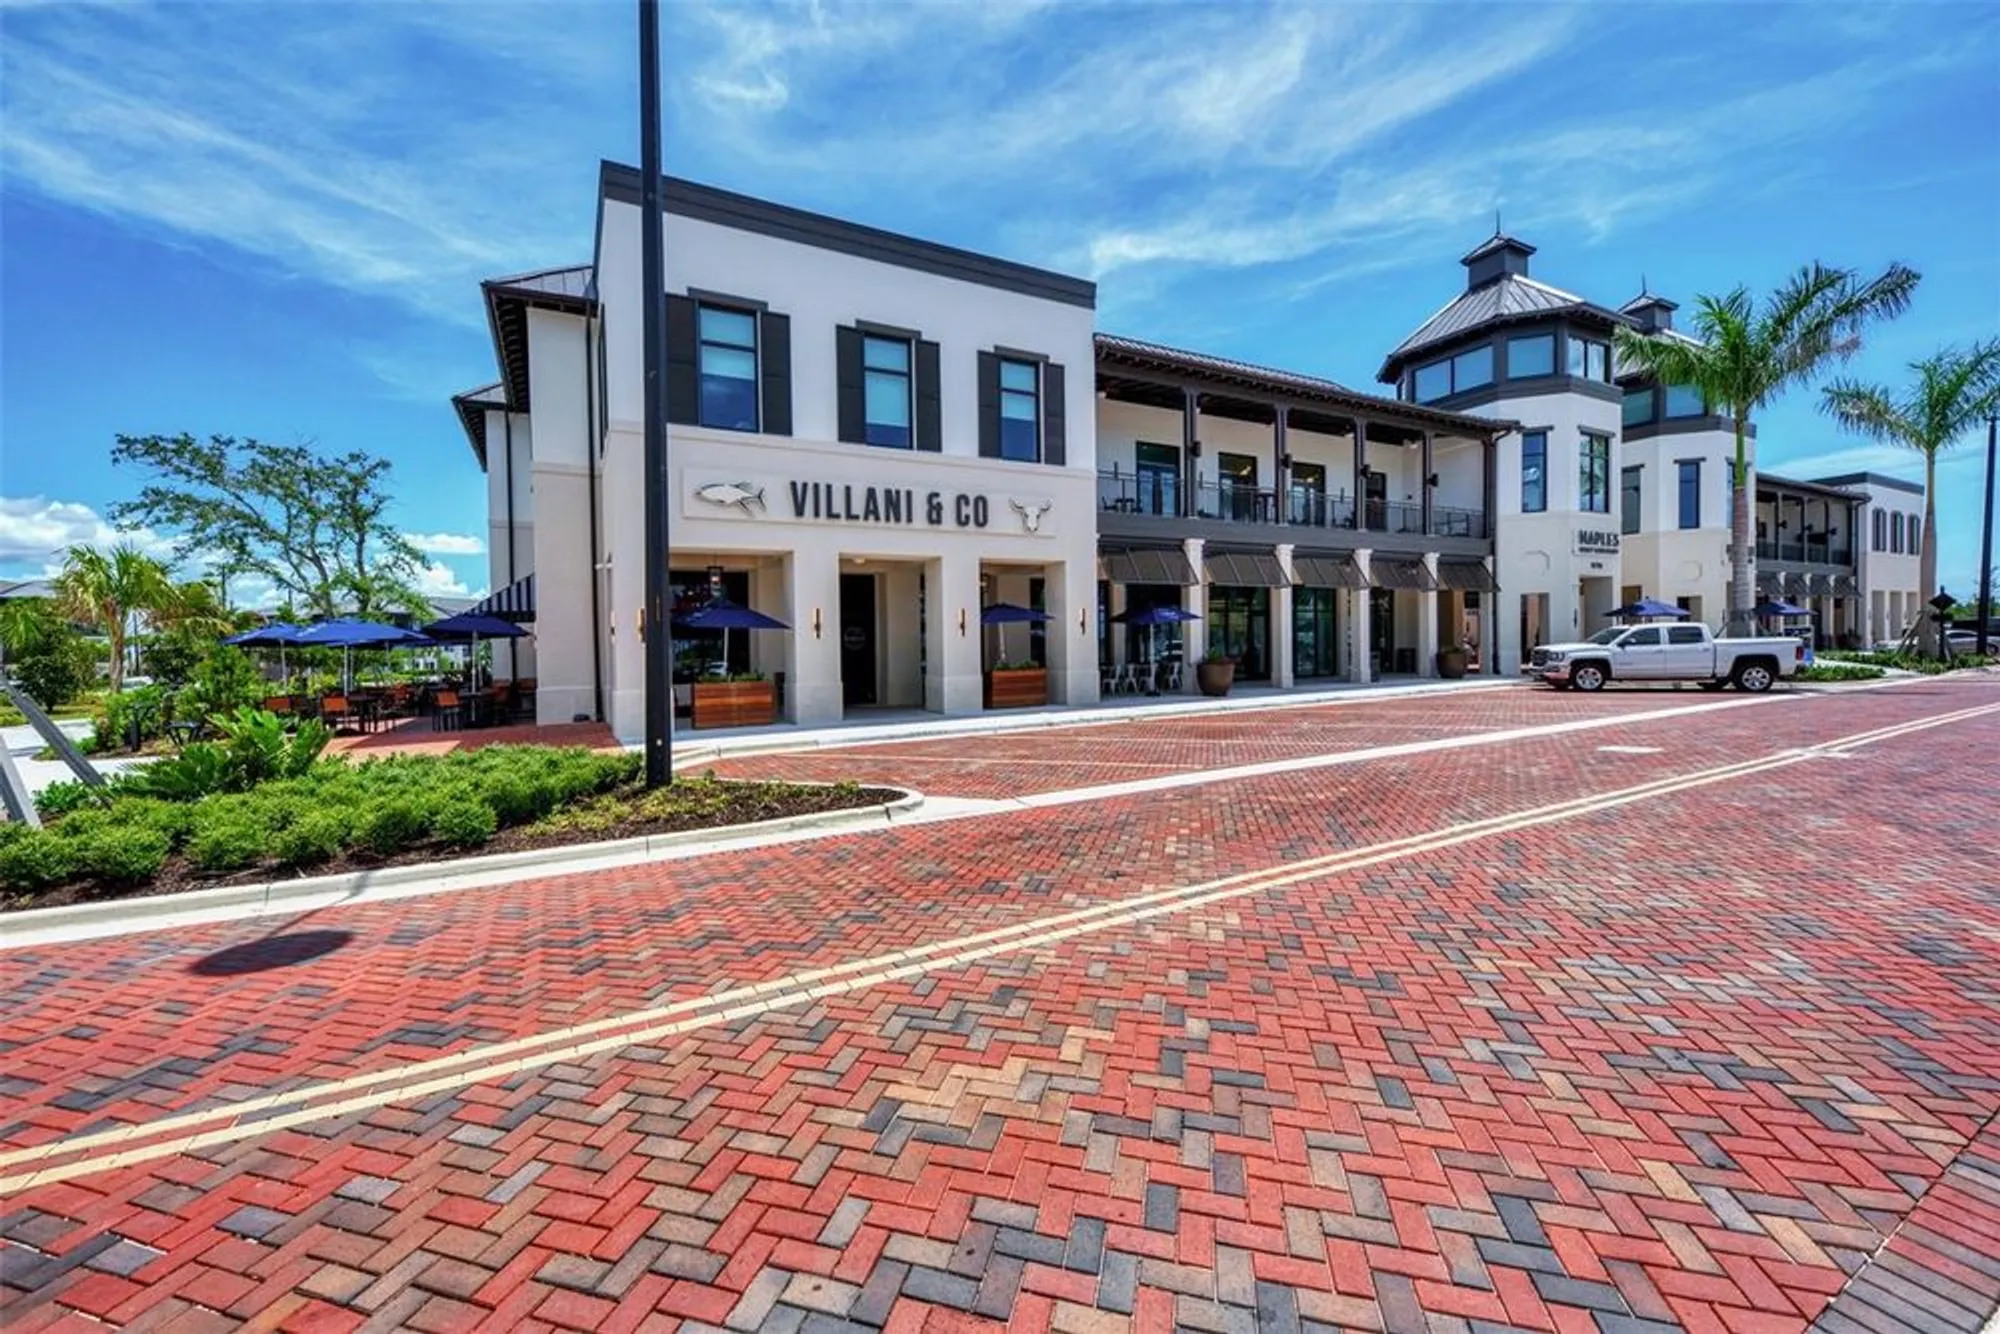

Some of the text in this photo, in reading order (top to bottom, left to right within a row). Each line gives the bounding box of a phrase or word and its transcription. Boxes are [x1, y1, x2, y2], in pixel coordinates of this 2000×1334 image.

[790, 480, 989, 528] VILLANI & CO
